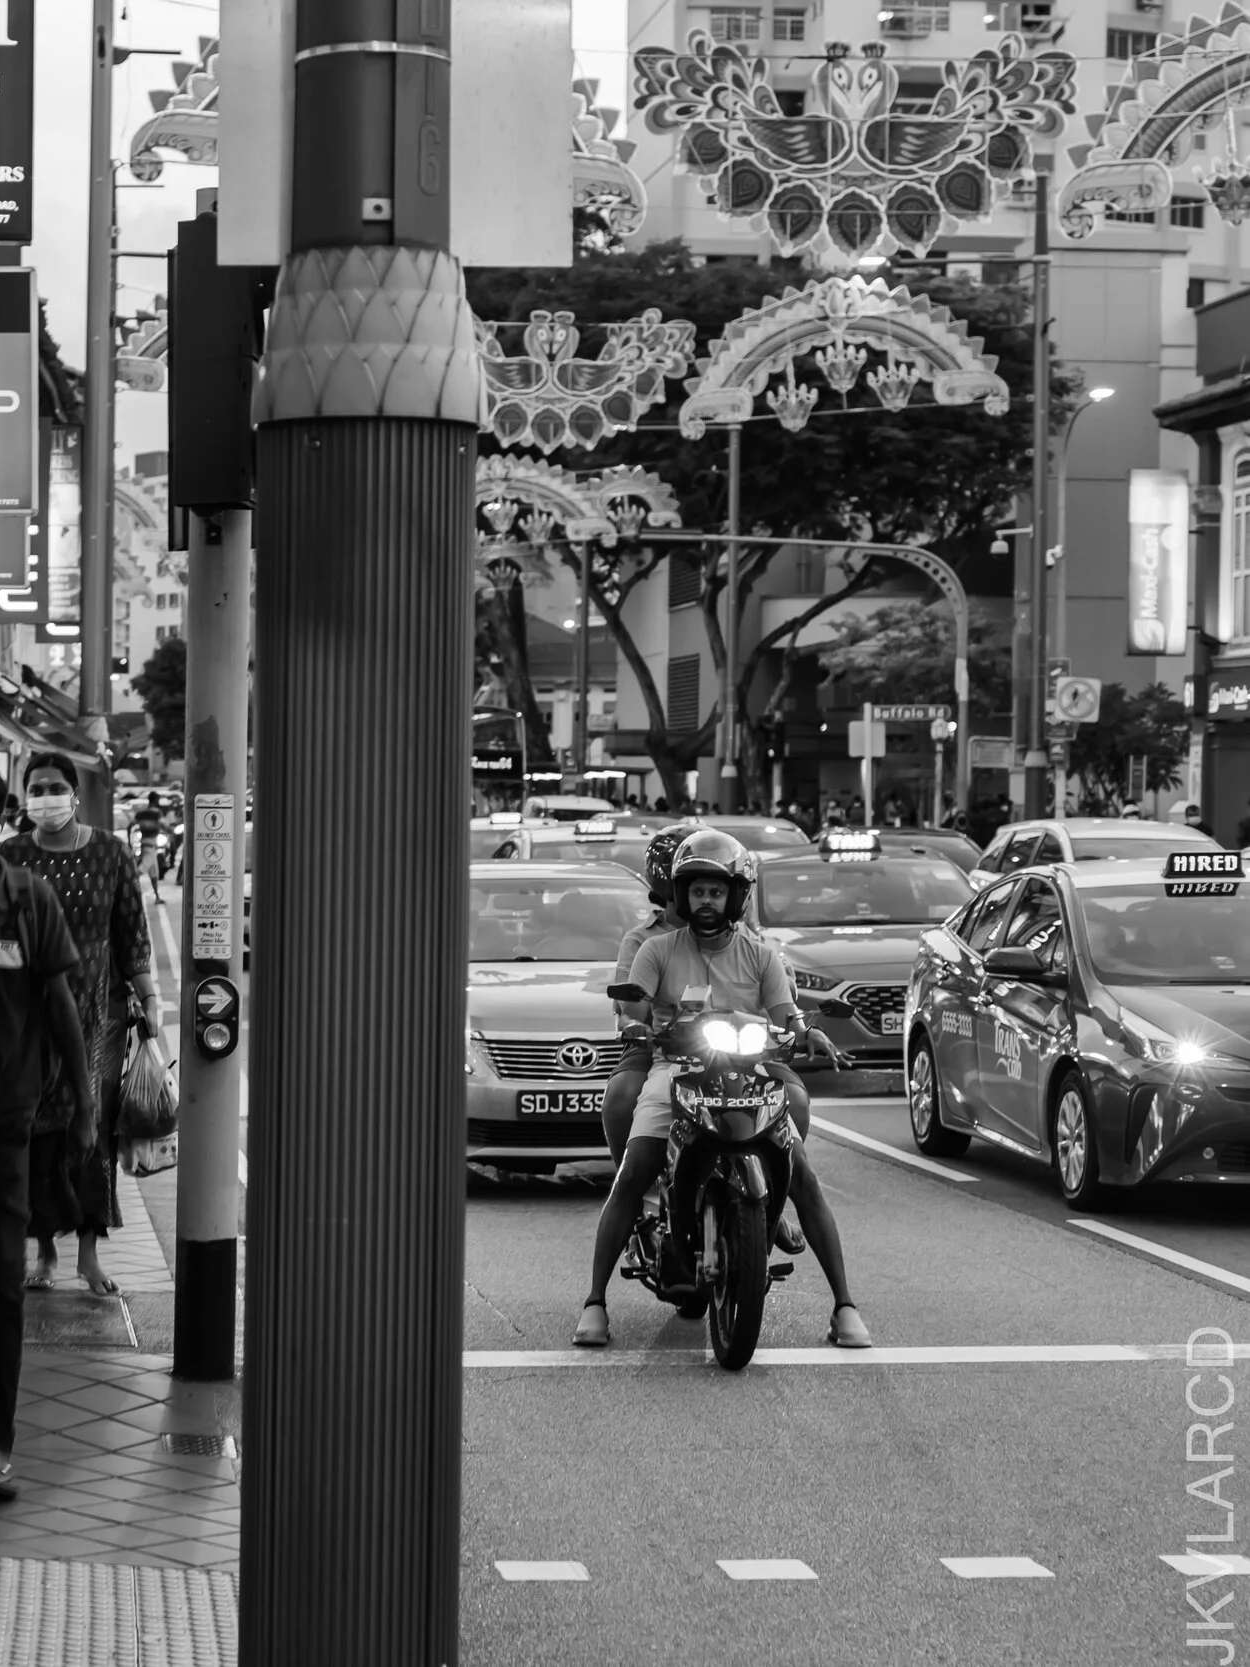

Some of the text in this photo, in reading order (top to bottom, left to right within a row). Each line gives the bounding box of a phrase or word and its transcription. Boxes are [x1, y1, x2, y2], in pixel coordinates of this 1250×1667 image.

[874, 706, 945, 719] Buffalo Rd
[1174, 855, 1238, 872] HIRED
[727, 1097, 764, 1107] 2005
